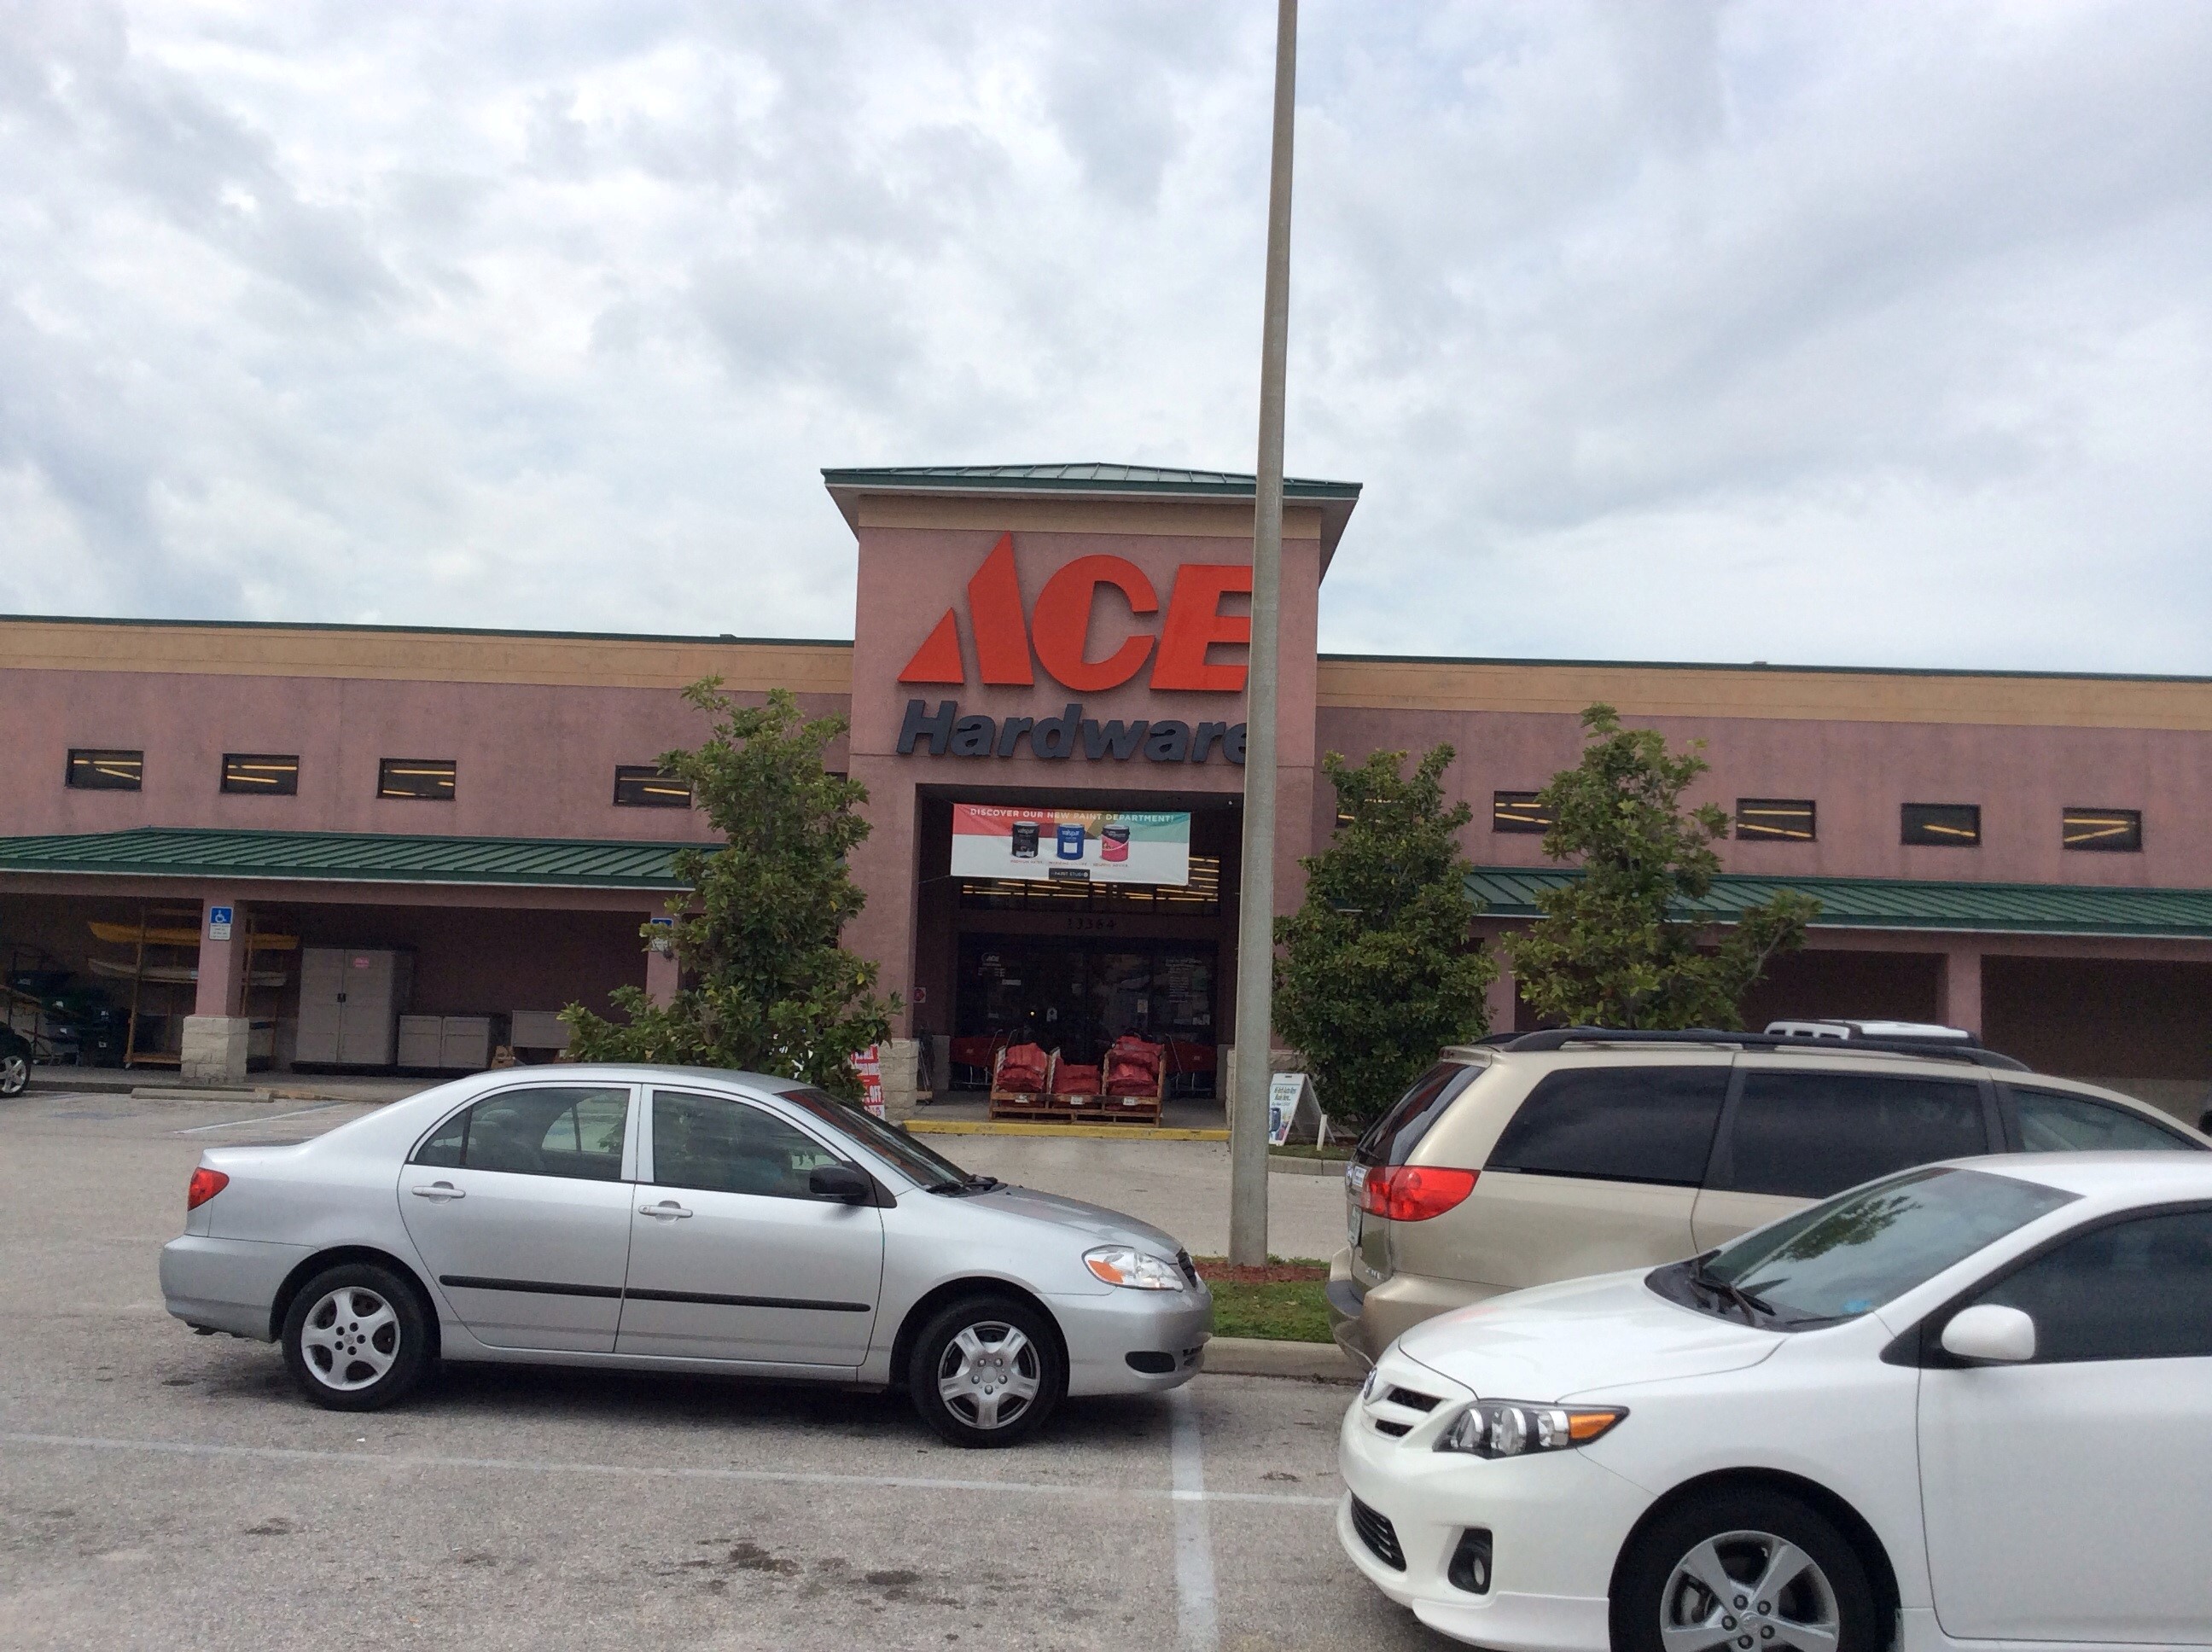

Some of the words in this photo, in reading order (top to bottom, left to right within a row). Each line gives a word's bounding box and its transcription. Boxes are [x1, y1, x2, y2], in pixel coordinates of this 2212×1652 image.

[898, 530, 1253, 692] ACE
[897, 700, 1248, 764] Hardware
[969, 808, 1019, 817] DISCOVER
[1046, 811, 1070, 820] NEW
[1073, 812, 1103, 821] PAINT
